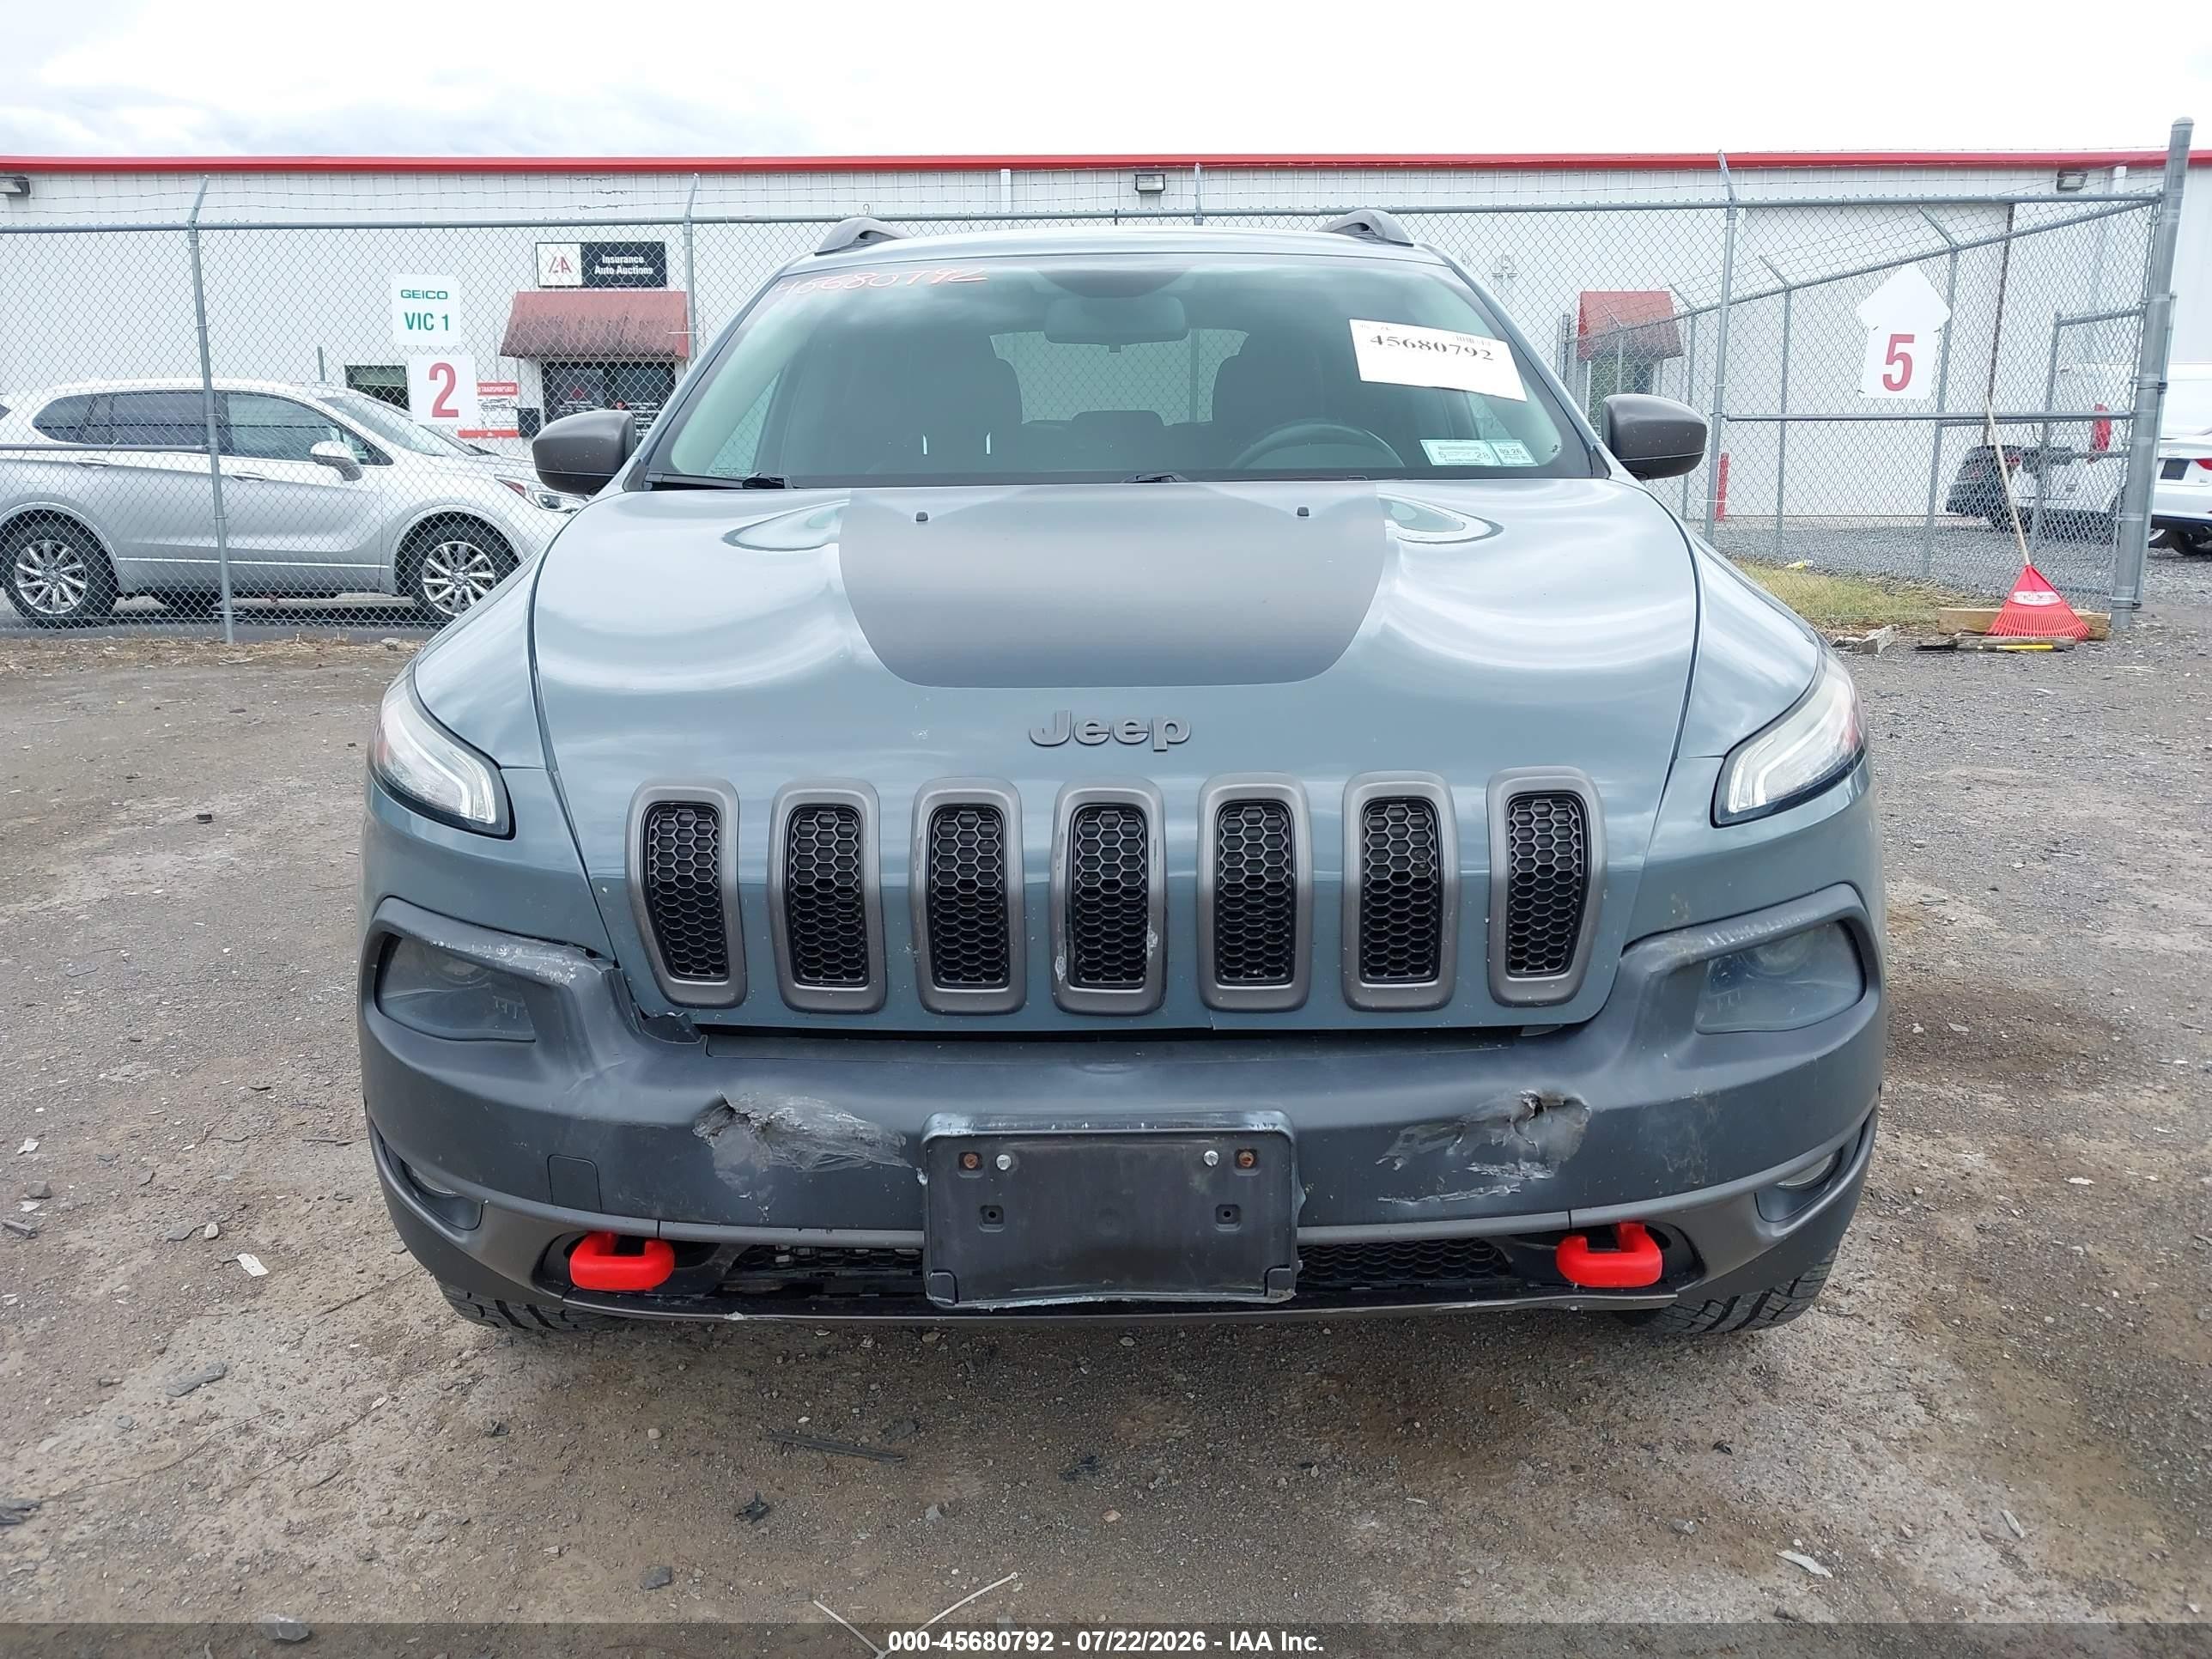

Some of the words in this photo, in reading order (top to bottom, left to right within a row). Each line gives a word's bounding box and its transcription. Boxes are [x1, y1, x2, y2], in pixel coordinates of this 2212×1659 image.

[594, 265, 614, 275] Auto
[617, 265, 653, 275] Auctions
[602, 254, 644, 264] Insurance
[400, 289, 448, 300] GEICO
[404, 312, 434, 331] VIC
[441, 313, 449, 331] 1
[1370, 335, 1494, 361] 45680792
[1882, 333, 1915, 392] 5
[428, 362, 459, 418] 2
[1029, 710, 1191, 752] Jeep
